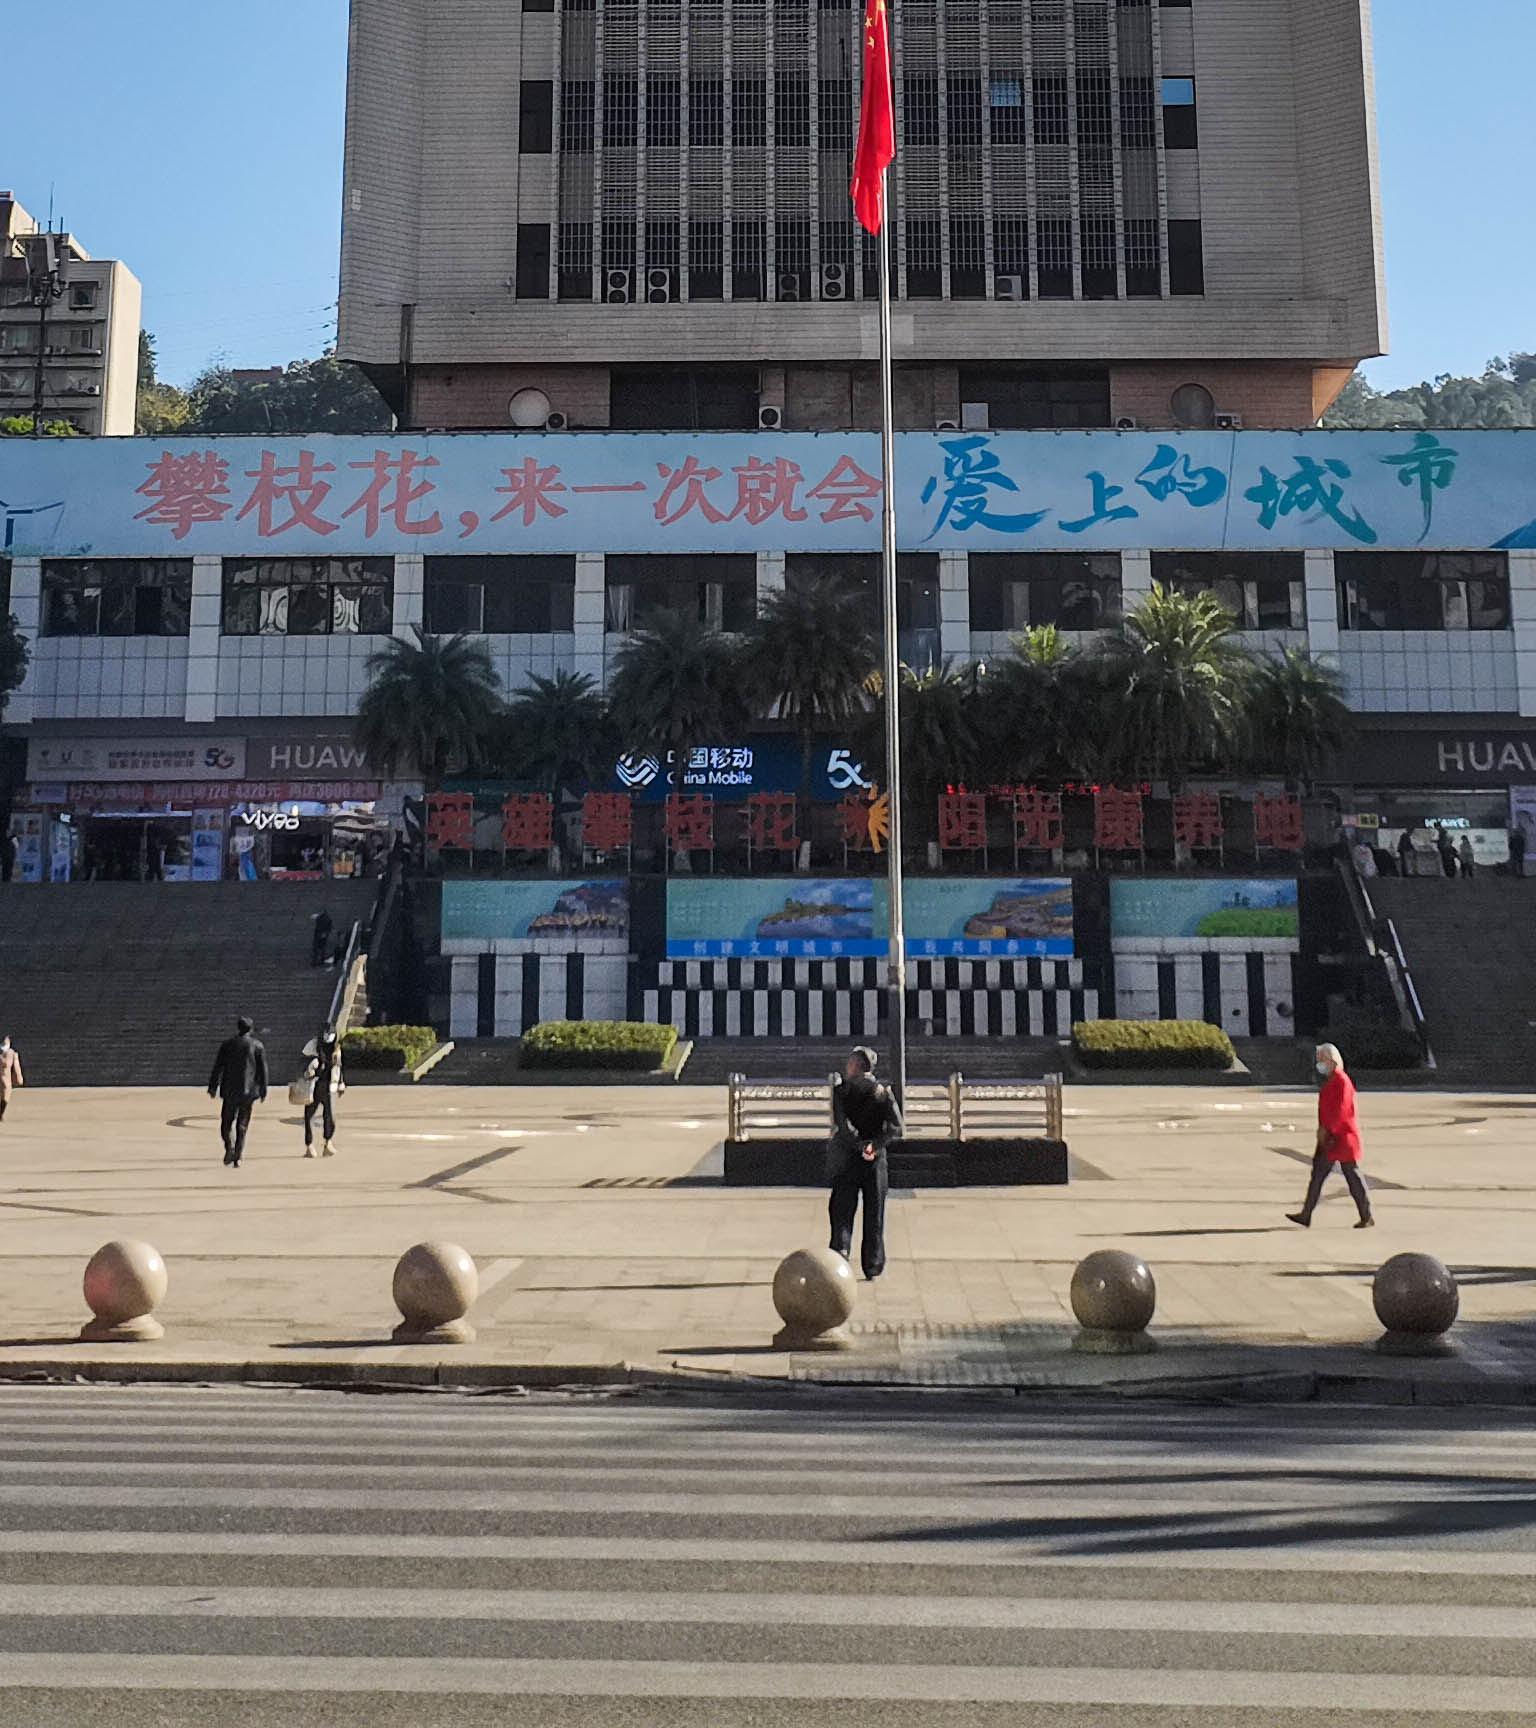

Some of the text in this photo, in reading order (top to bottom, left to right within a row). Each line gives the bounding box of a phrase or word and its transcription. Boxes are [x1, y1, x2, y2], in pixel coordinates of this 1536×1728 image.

[269, 744, 367, 770] HUAW
[708, 770, 754, 785] Mobile
[424, 789, 1304, 851] 英雄攀枝花 阳光康养地
